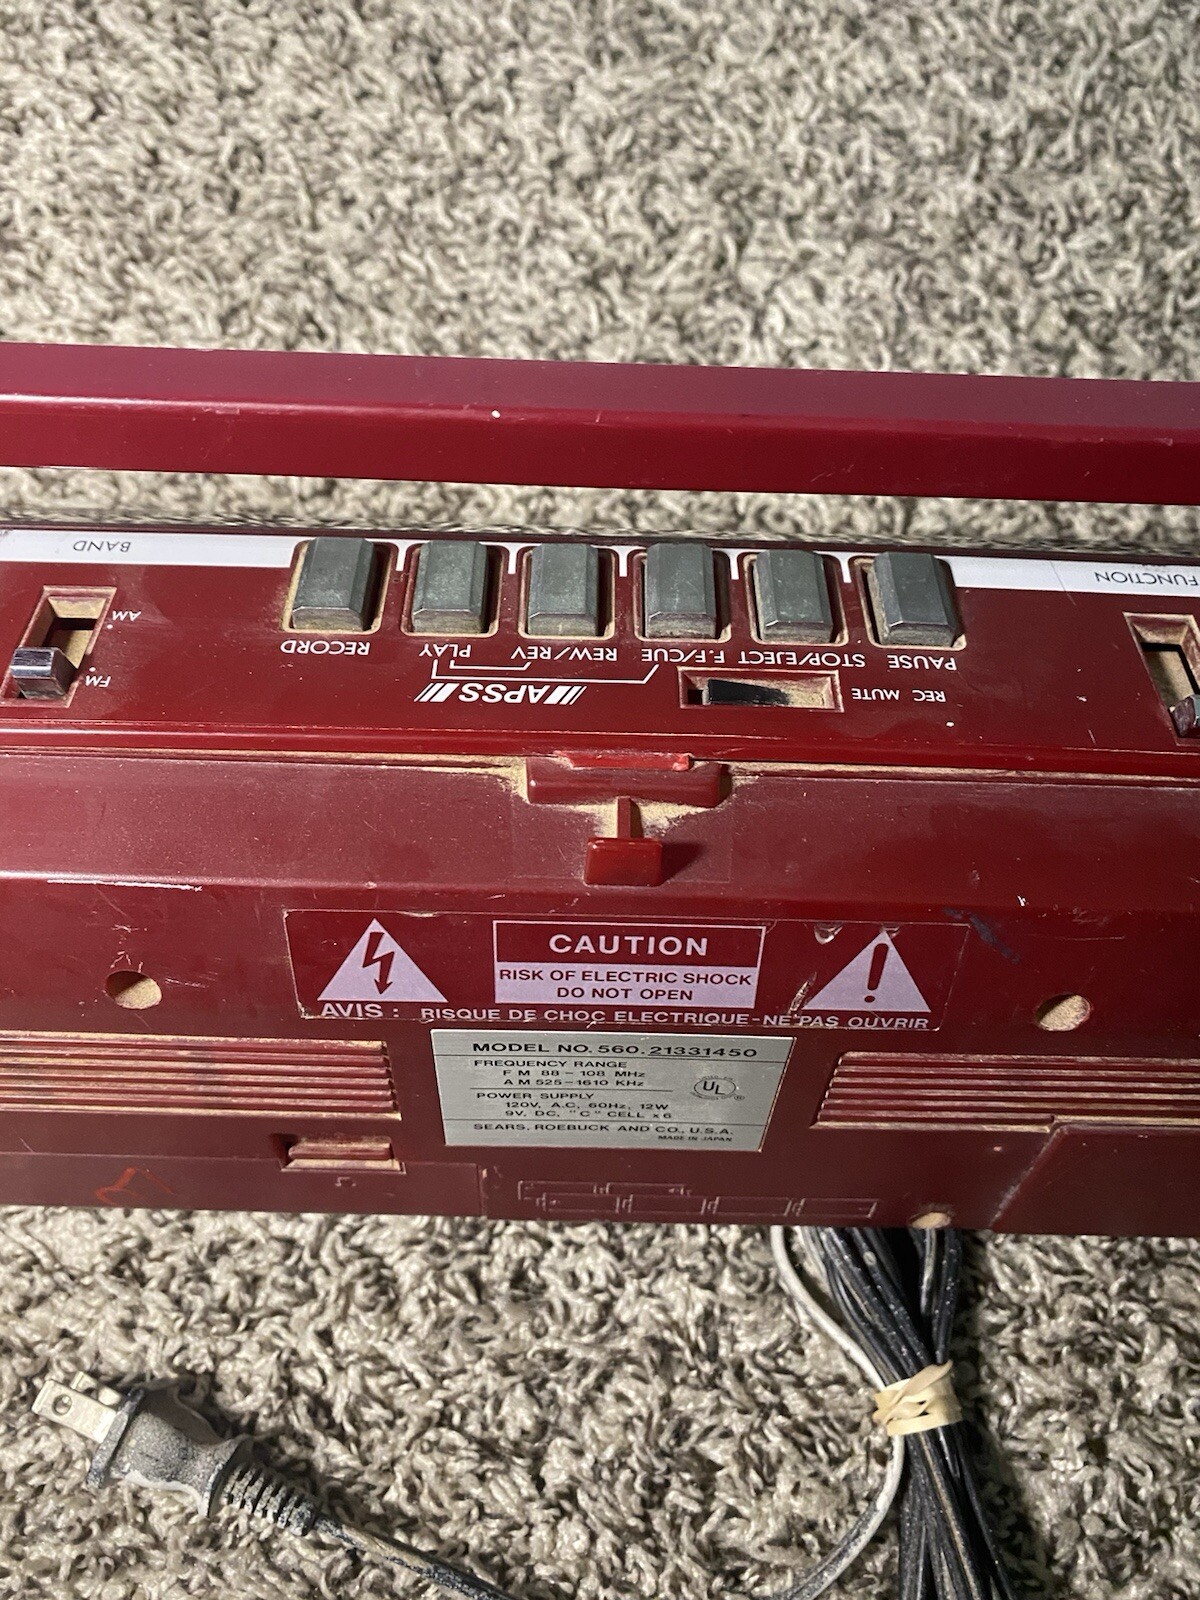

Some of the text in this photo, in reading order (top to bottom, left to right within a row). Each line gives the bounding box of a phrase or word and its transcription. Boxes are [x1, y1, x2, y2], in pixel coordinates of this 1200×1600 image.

[73, 540, 131, 553] BAND
[1095, 571, 1198, 586] FUNCTION
[112, 610, 142, 622] AM
[280, 640, 371, 656] RECORD
[419, 643, 472, 658] PLAY
[510, 645, 618, 662] REW/REV
[738, 650, 866, 668] STOP/EJECT
[886, 654, 957, 671] PAUSE
[85, 675, 112, 688] FM
[458, 683, 551, 704] APSS
[851, 687, 946, 703] REC MUTE
[549, 933, 709, 957] CAUTION
[499, 969, 752, 986] RISK OF ELECTRIC SHOCK
[557, 987, 693, 1001] DO NOT OPEN
[320, 1003, 384, 1018] AVIS
[420, 1008, 500, 1021] RISQUE
[508, 1009, 537, 1021] DE
[543, 1010, 606, 1022] CHOC
[799, 1015, 839, 1027] PAS
[847, 1017, 929, 1029] OUVRIR
[472, 1043, 550, 1053] MODEL
[557, 1044, 593, 1054] NO.
[703, 1081, 725, 1095] UL
